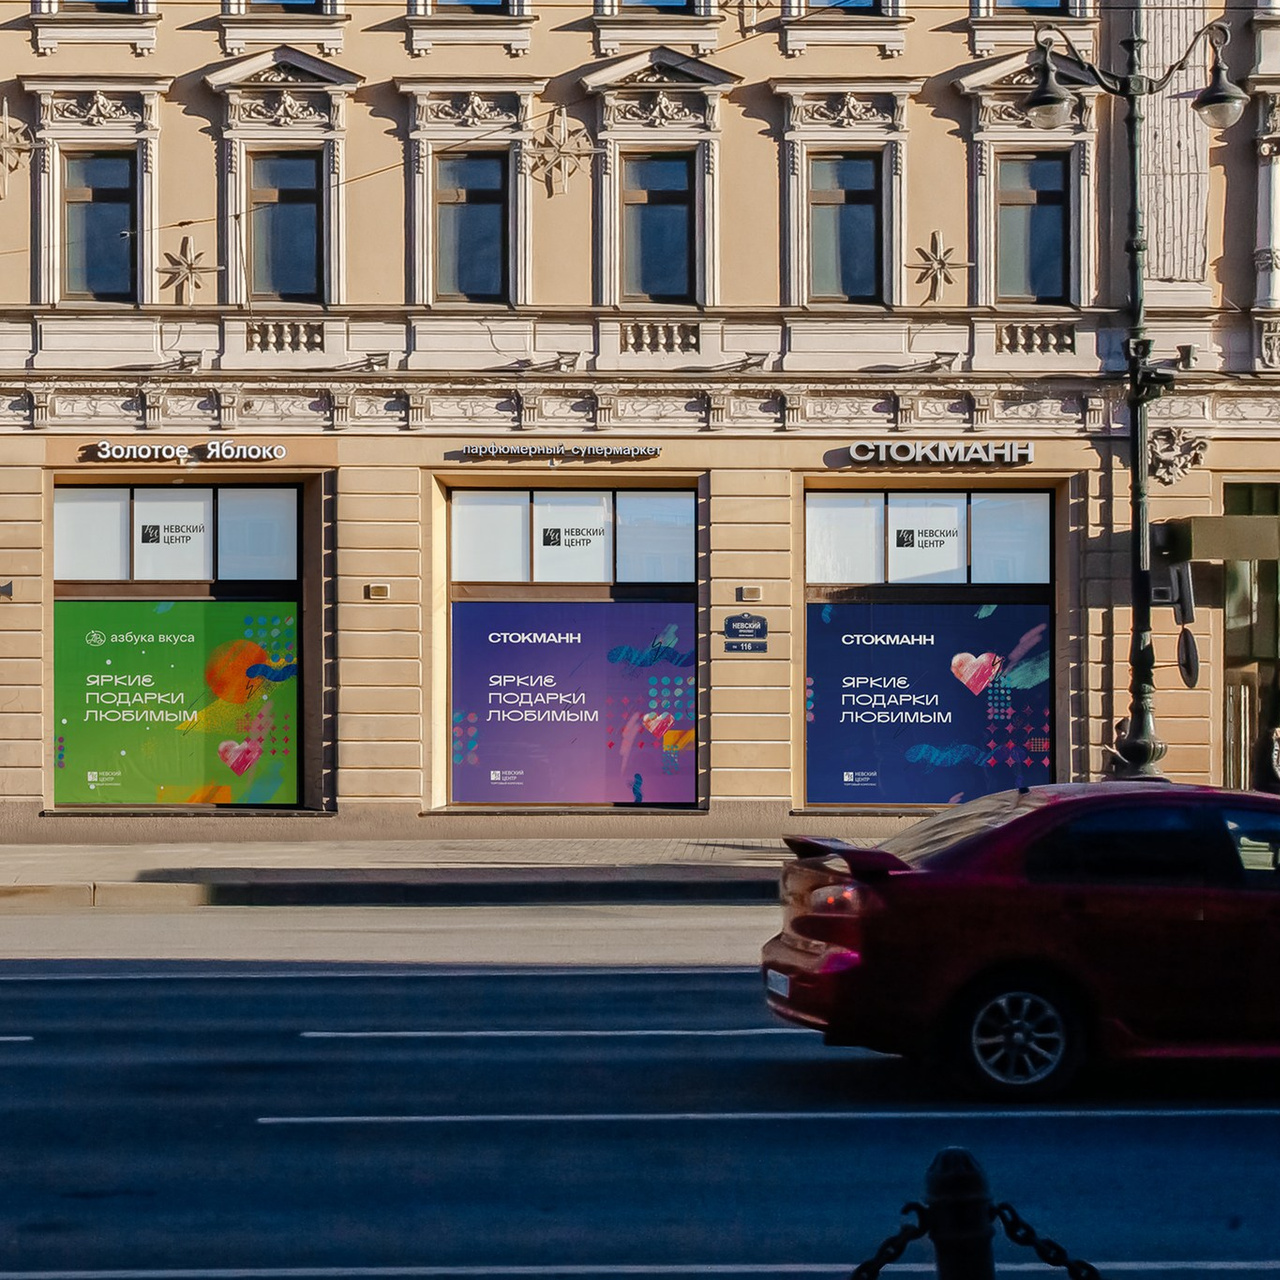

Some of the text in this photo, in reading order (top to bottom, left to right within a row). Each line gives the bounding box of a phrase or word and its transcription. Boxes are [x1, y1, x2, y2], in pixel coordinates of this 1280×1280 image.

[97, 440, 286, 459] Золотое Яблоко
[463, 442, 662, 456] парфюмерный супермаркет
[849, 441, 1035, 463] СТОКМАНН
[163, 523, 205, 533] НЕВСКИЙ
[564, 527, 605, 536] НЕВСКИЙ
[918, 528, 958, 537] НЕВСКИЙ
[163, 535, 191, 545] ЦЕНТР
[564, 539, 591, 547] ЦЕНТР
[918, 540, 945, 549] ЦЕНТР
[110, 631, 155, 645] азбука
[159, 634, 195, 645] вкуса
[488, 632, 581, 644] СТОКМАНН
[841, 634, 935, 645] СТОКМАНН
[85, 692, 185, 707] ПОДАРКИ
[488, 692, 586, 707] ПОДАРКИ
[841, 694, 939, 708] ПОДАРКИ
[84, 710, 198, 722] ЛЮБИМЫМ
[486, 710, 599, 722] ЛЮБИМЫМ
[839, 711, 952, 724] ЛЮБИМЫМ
